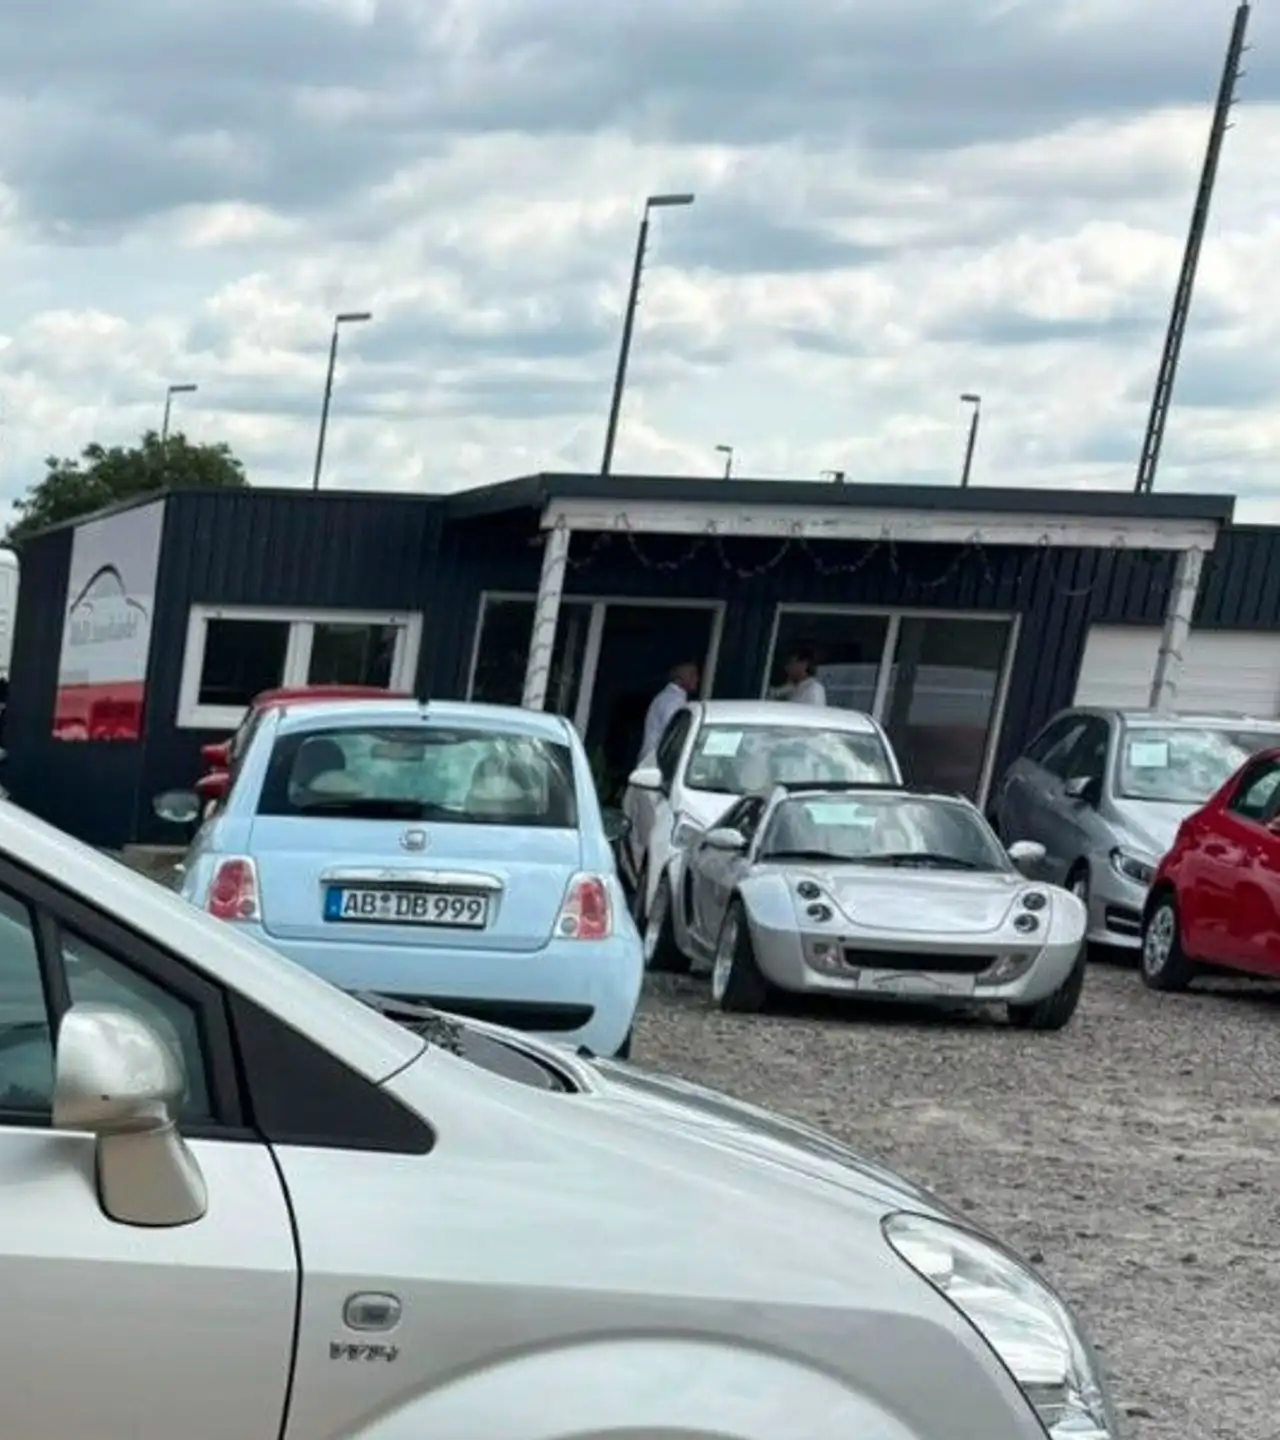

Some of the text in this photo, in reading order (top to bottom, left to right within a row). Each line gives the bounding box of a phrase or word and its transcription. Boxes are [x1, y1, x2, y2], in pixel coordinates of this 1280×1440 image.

[343, 892, 482, 921] AB DB 999
